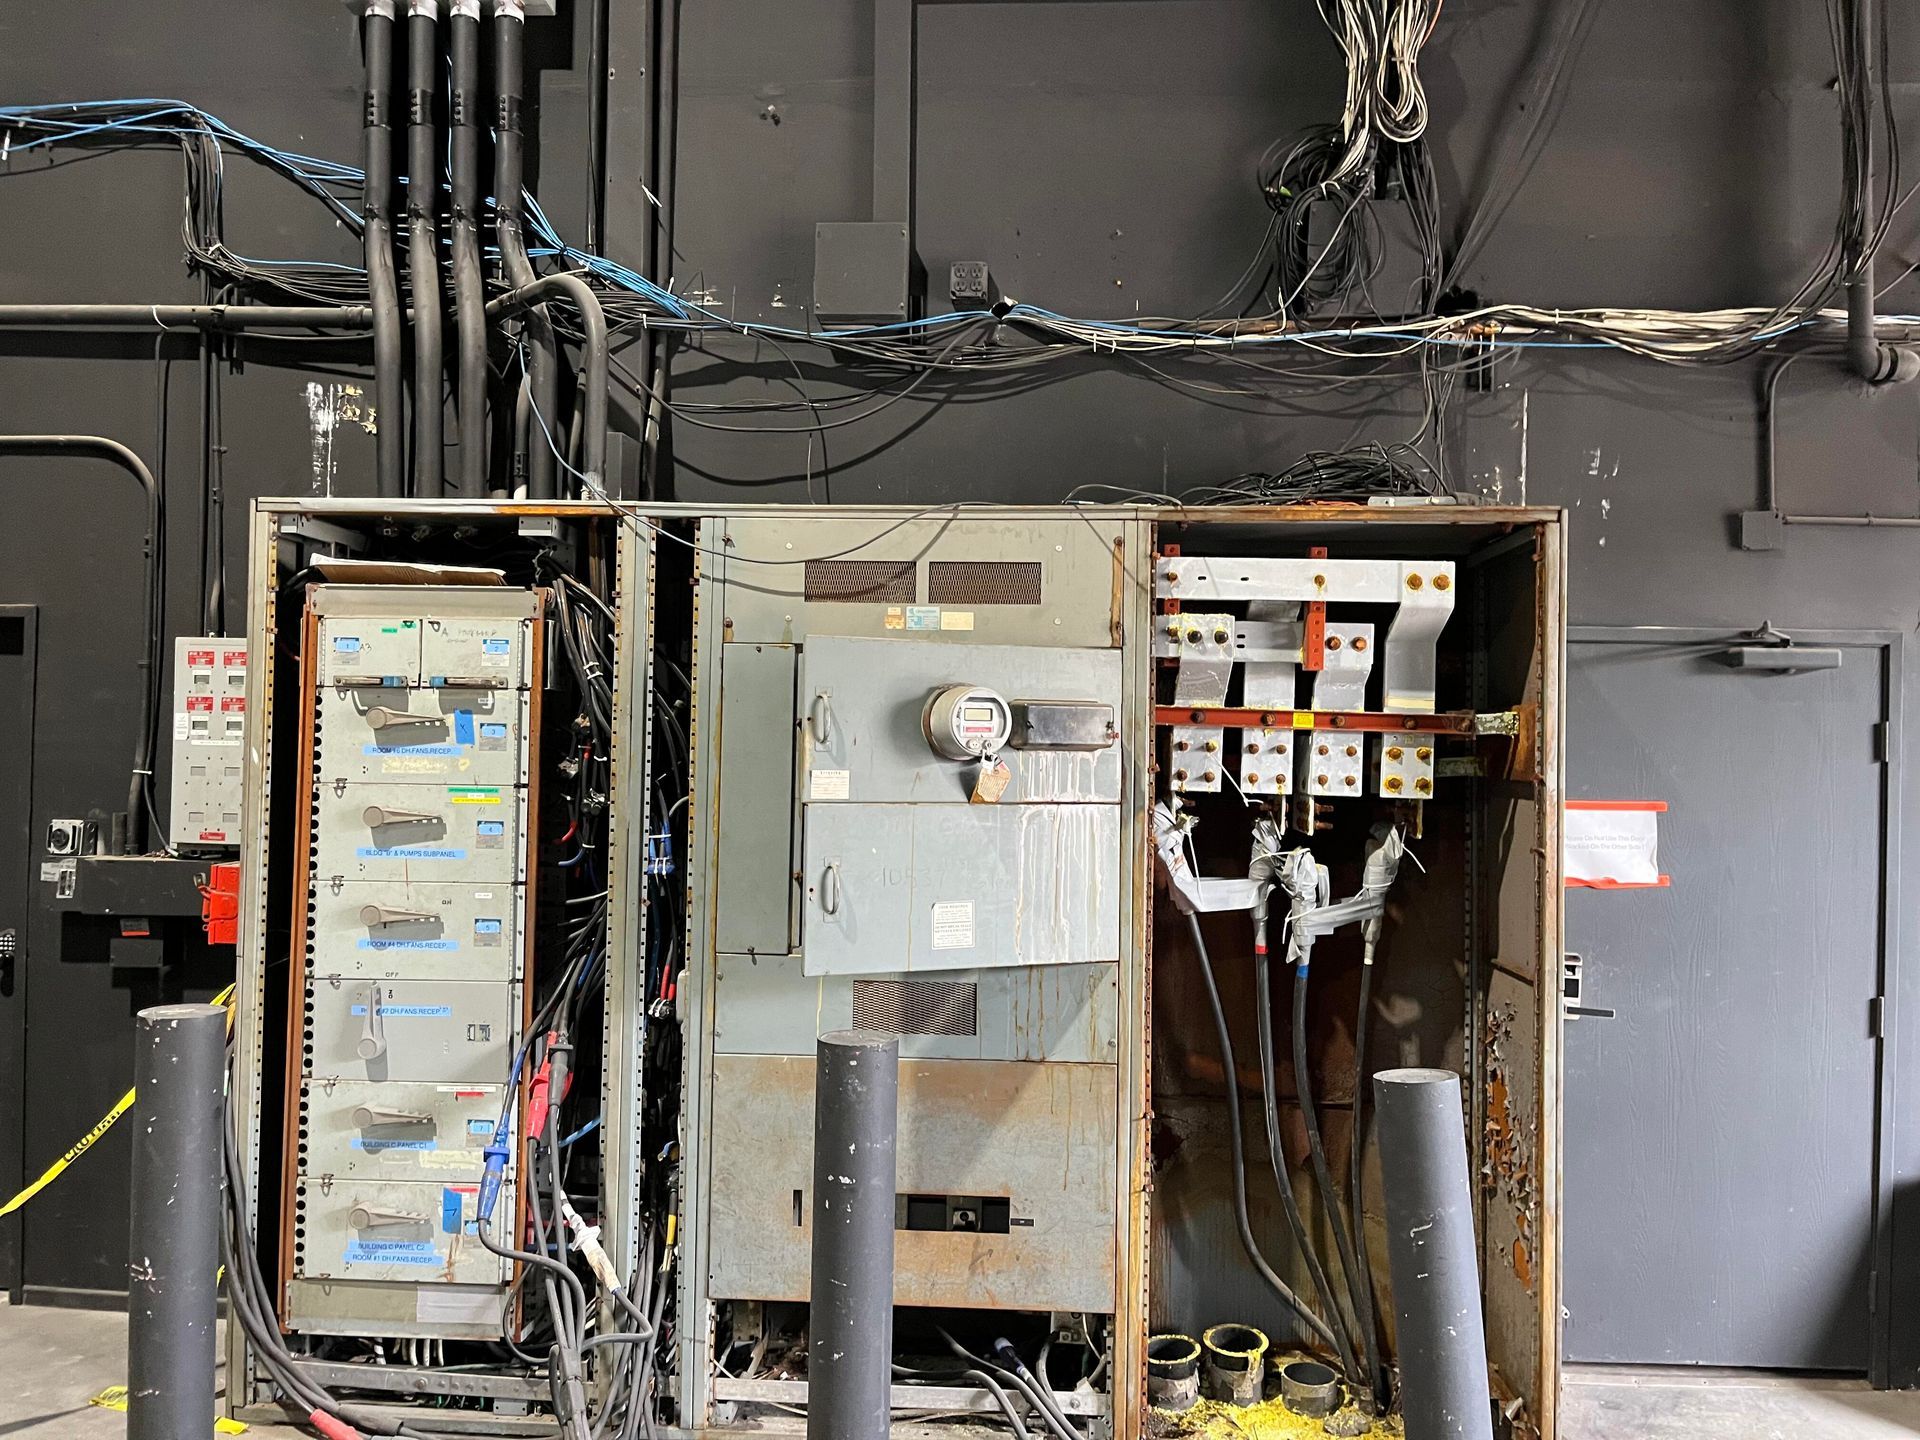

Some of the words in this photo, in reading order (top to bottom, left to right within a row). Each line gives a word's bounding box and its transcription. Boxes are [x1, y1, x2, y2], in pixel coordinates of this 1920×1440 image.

[400, 850, 422, 858] PUMPS
[423, 850, 456, 859] SUBPANEL
[361, 1141, 391, 1149] BUILDING
[358, 1242, 388, 1250] BUILDING
[394, 1243, 415, 1251] PANEL
[415, 1243, 425, 1251] C2
[352, 1253, 372, 1261] ROOM
